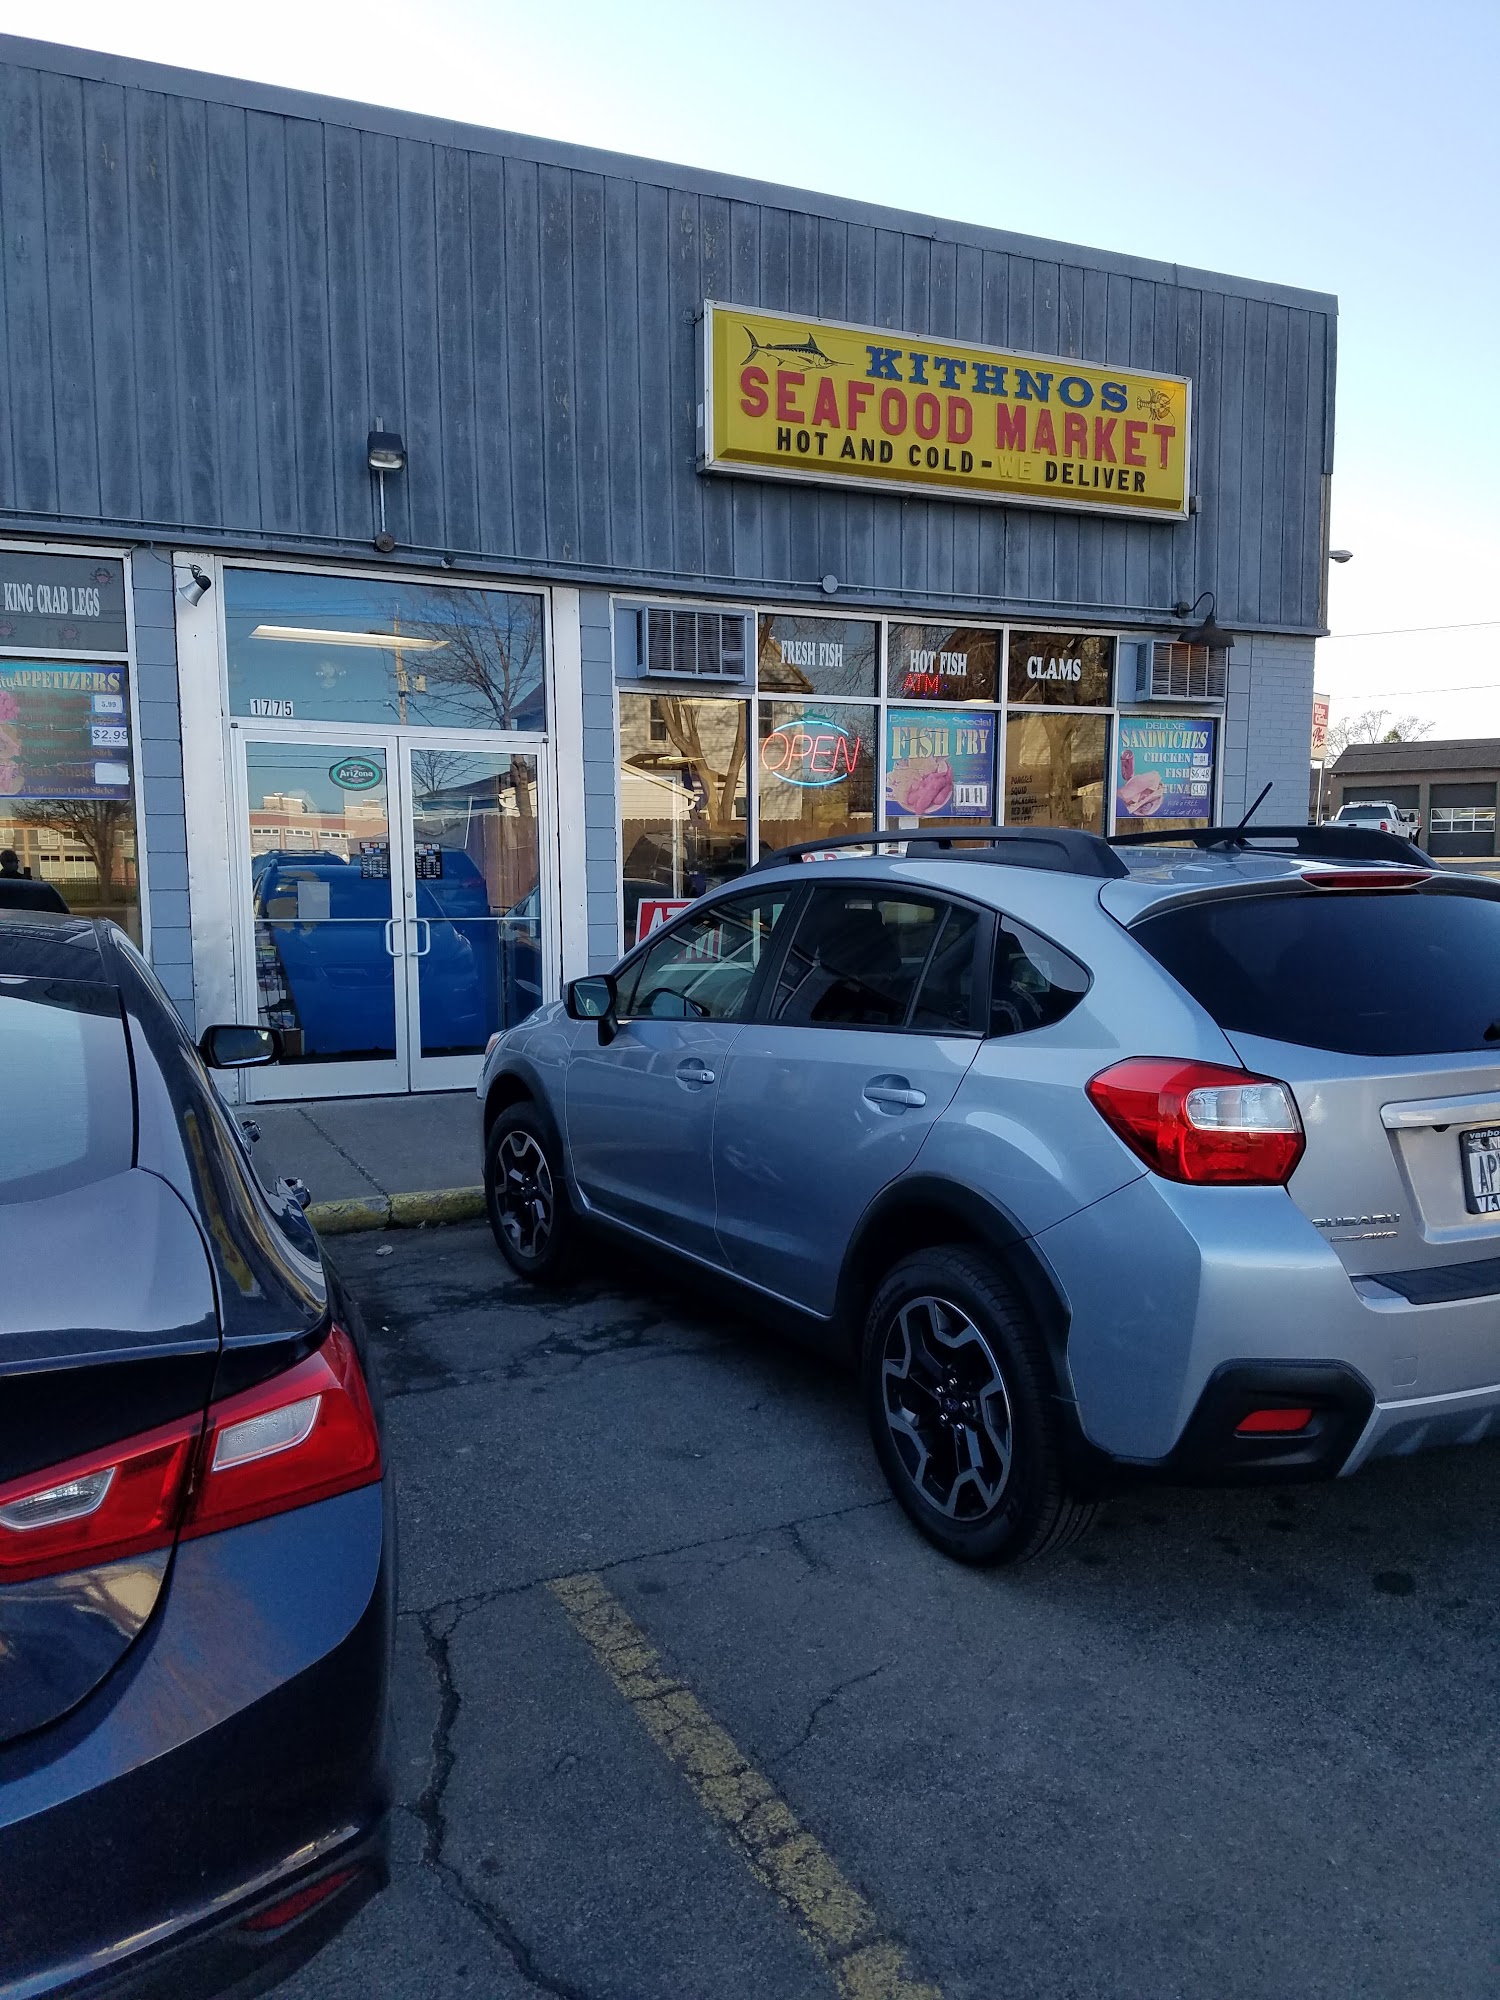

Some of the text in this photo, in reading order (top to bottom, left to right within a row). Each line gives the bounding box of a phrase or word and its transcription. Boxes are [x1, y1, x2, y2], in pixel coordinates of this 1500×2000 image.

[865, 345, 1128, 413] KITHNOS
[739, 365, 1176, 470] SEAFOOD MARKET
[777, 426, 829, 456] HOT
[840, 435, 893, 463] AND
[1044, 460, 1146, 493] DELIVER
[3, 582, 100, 617] KING CRAB LEGS
[781, 640, 844, 667] FRESH FISH
[909, 650, 968, 676] HOT FISH
[13, 670, 121, 692] APPETIZERS
[1027, 656, 1082, 681] CLAMS
[902, 673, 941, 693] ATM
[251, 699, 292, 716] 1775
[92, 729, 129, 740] $2.99
[891, 726, 990, 760] FISH FRY
[1120, 729, 1209, 749] SANDWICHES
[761, 732, 860, 773] OPEN
[1143, 752, 1191, 763] CHICKEN
[1165, 768, 1189, 778] FISH
[1311, 1214, 1400, 1228] SUBARU
